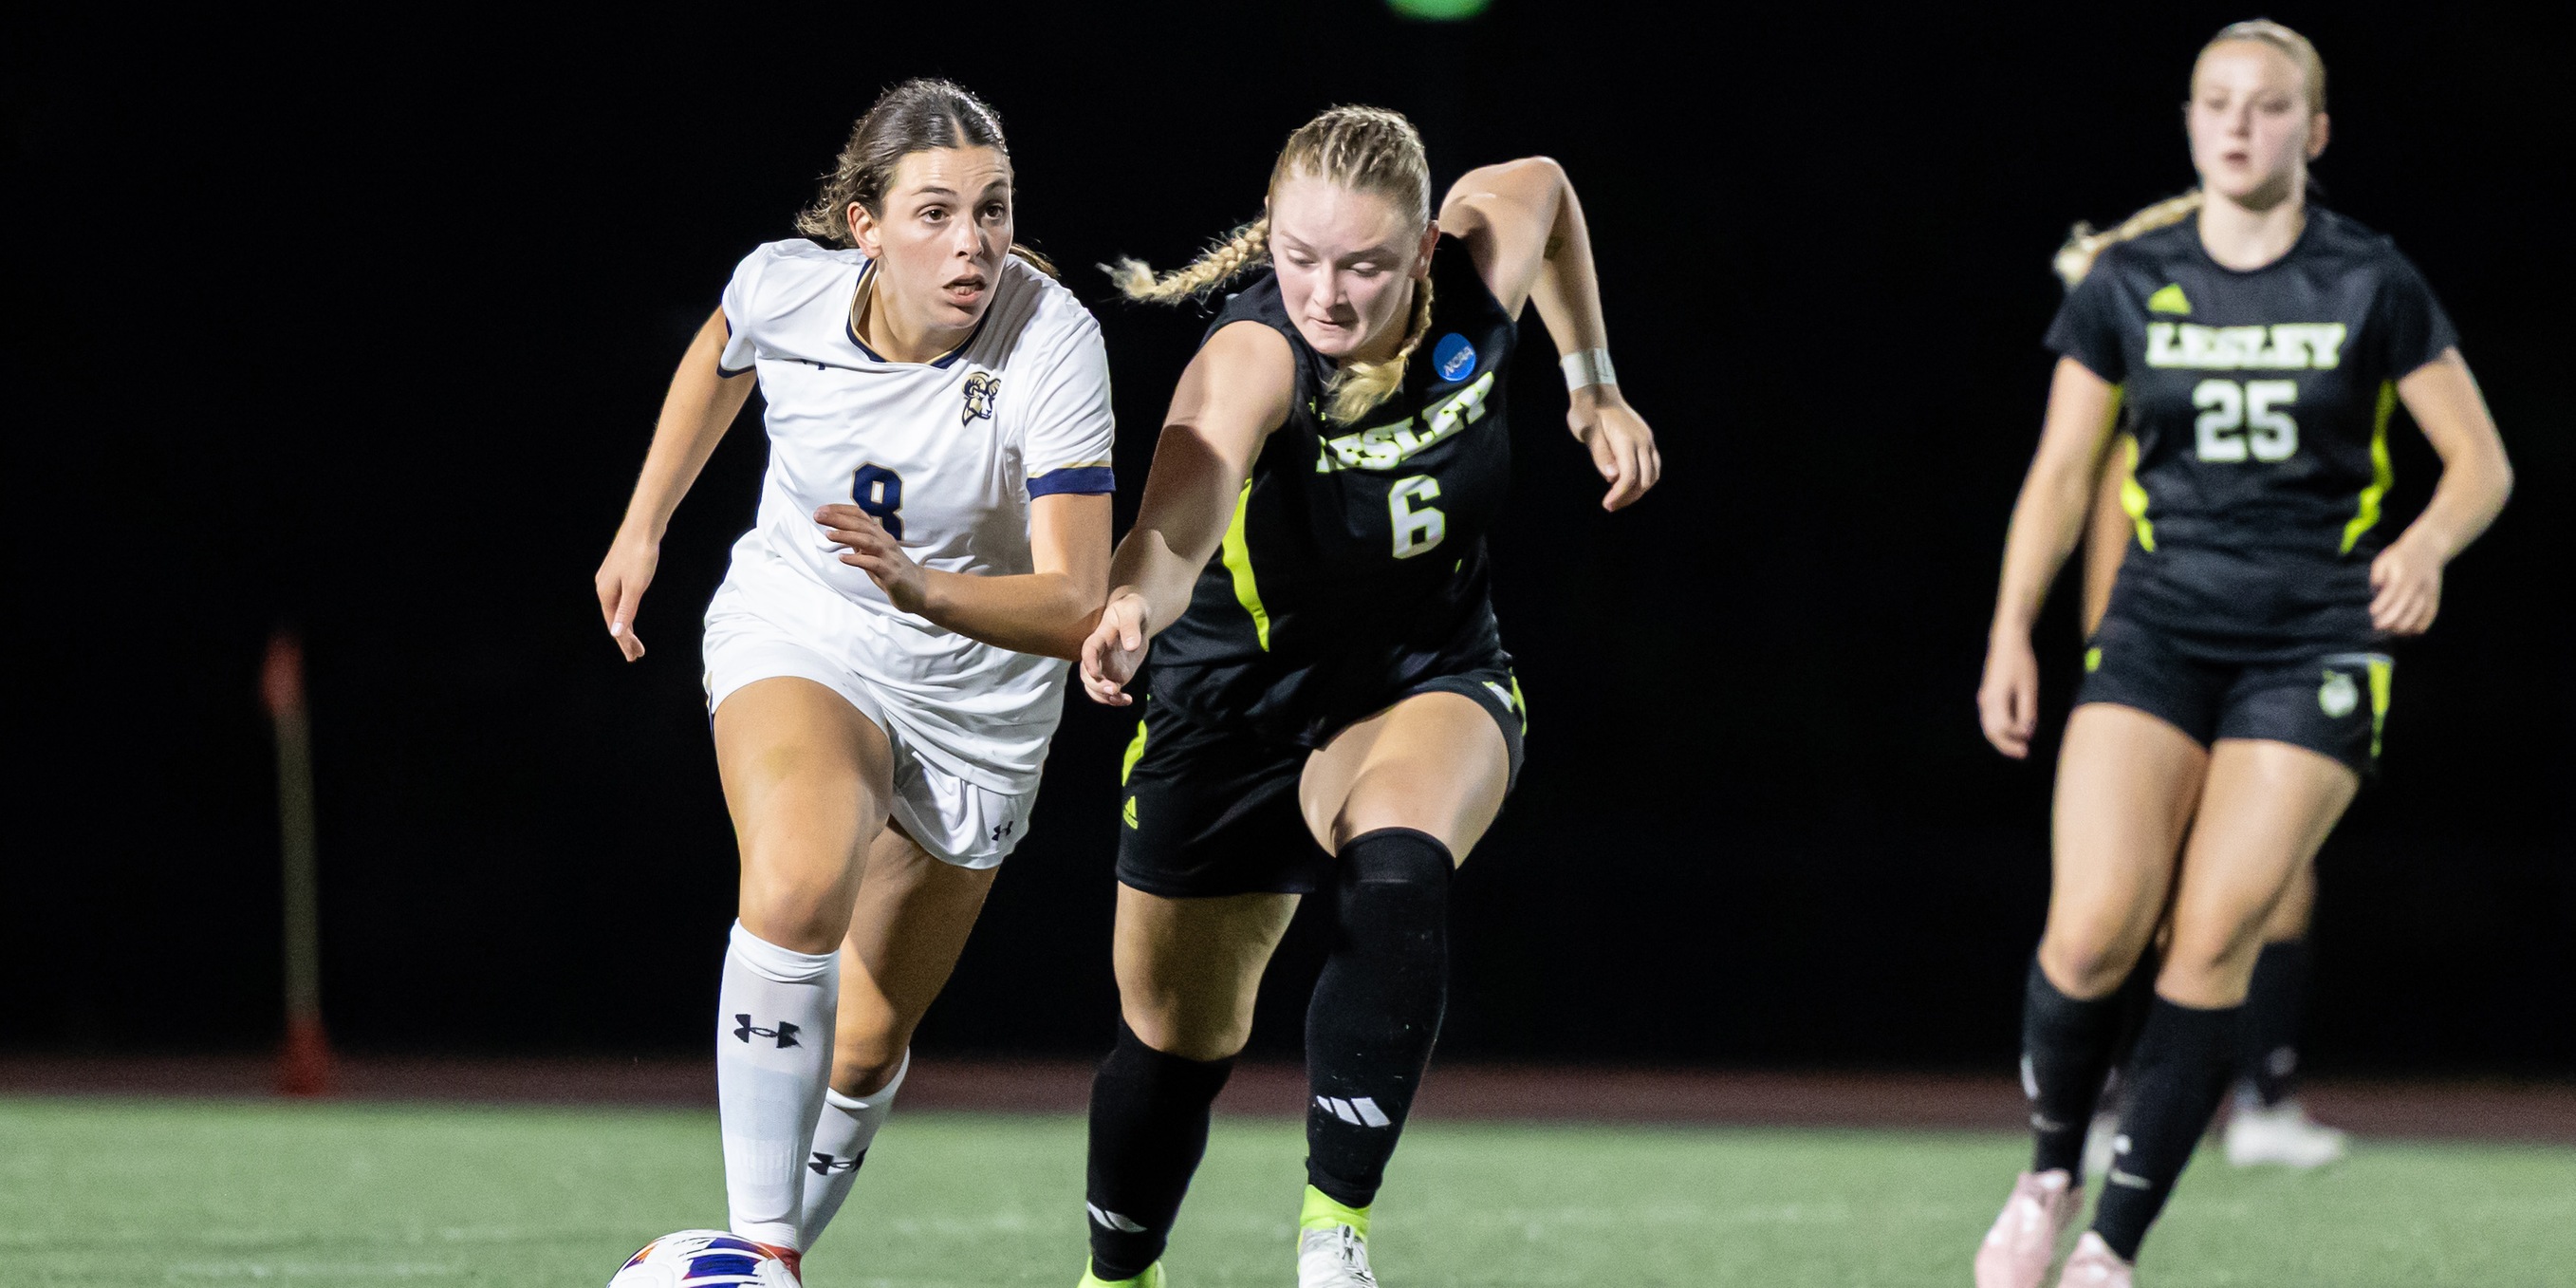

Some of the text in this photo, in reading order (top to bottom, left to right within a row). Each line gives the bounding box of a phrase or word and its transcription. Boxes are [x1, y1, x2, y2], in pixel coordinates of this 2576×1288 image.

[1443, 345, 1473, 377] NCAA
[2146, 322, 2346, 369] LESLEY
[2193, 380, 2298, 462] 25
[1388, 475, 1445, 559] 6
